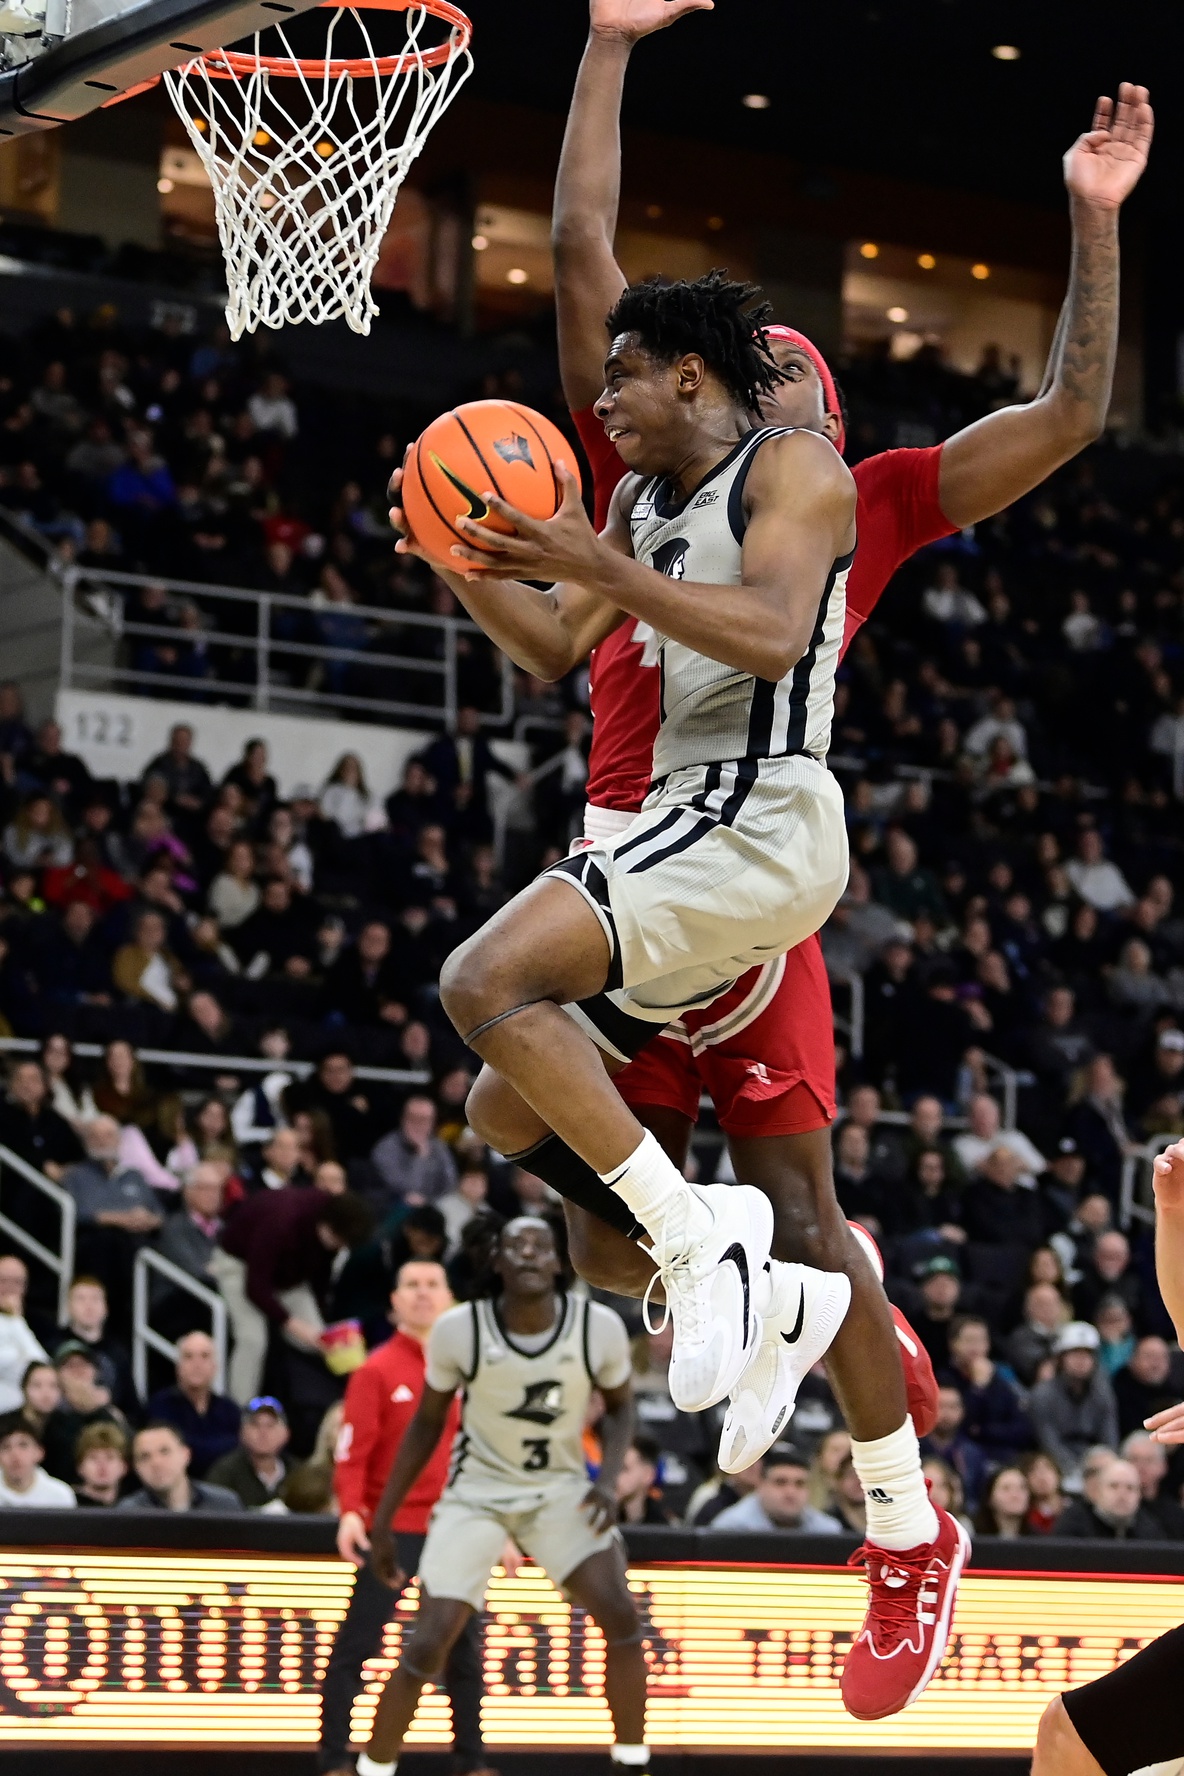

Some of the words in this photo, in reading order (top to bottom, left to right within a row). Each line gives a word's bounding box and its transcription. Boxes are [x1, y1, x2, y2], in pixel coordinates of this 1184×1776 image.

[694, 495, 720, 506] EAST
[699, 490, 718, 499] BIG
[76, 711, 134, 749] 122
[522, 1438, 550, 1471] 3
